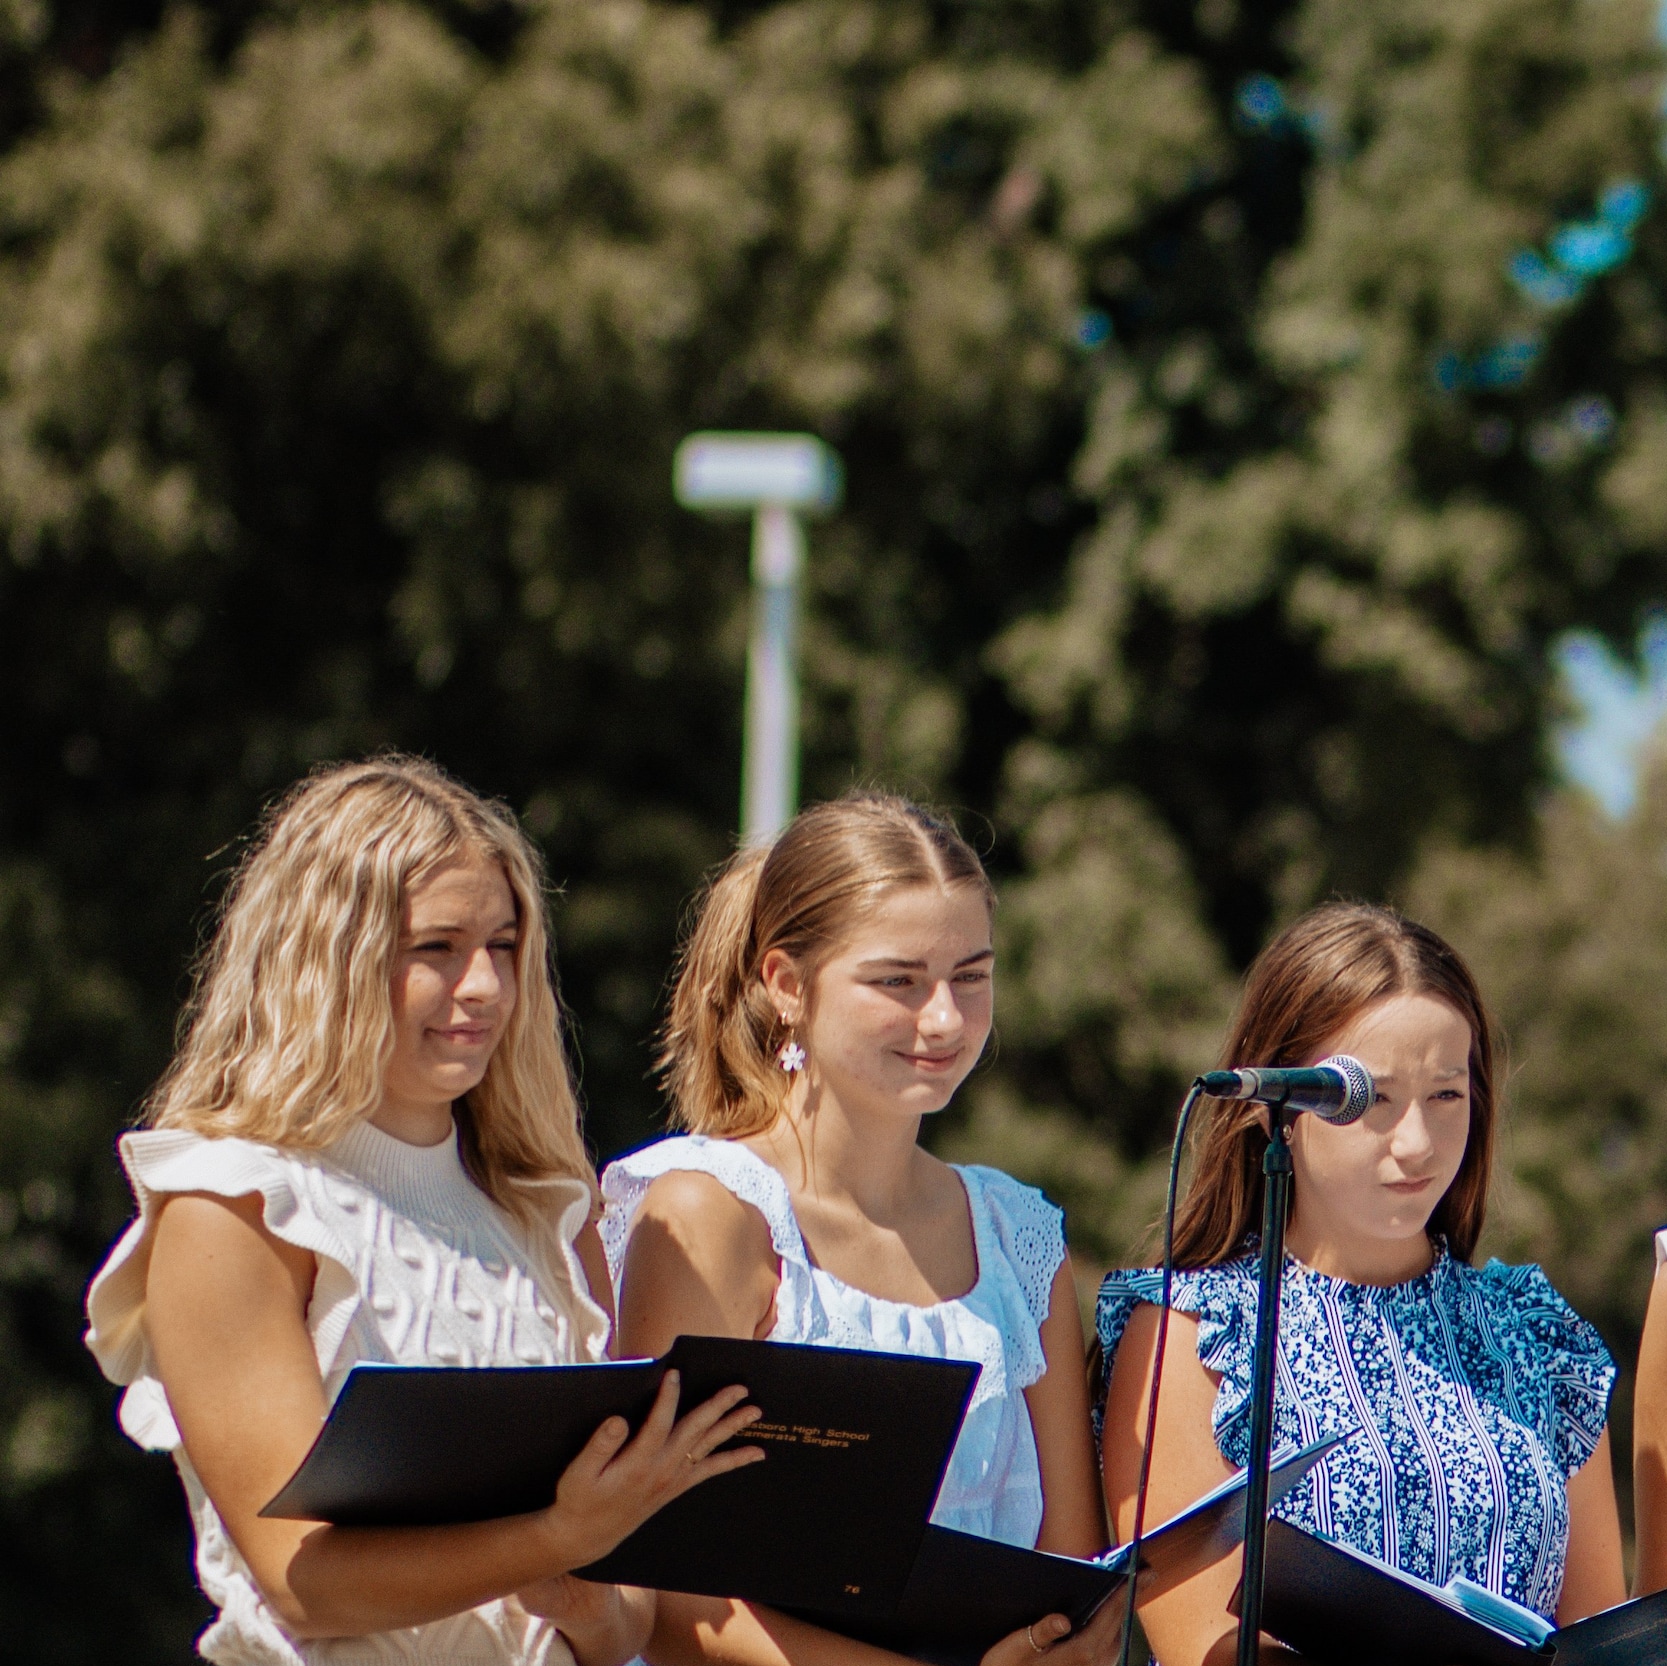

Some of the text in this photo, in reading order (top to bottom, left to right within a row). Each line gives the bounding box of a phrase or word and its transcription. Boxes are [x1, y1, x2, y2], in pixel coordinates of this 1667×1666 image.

[793, 1425, 820, 1436] High
[826, 1428, 870, 1441] School
[802, 1435, 849, 1447] Singers
